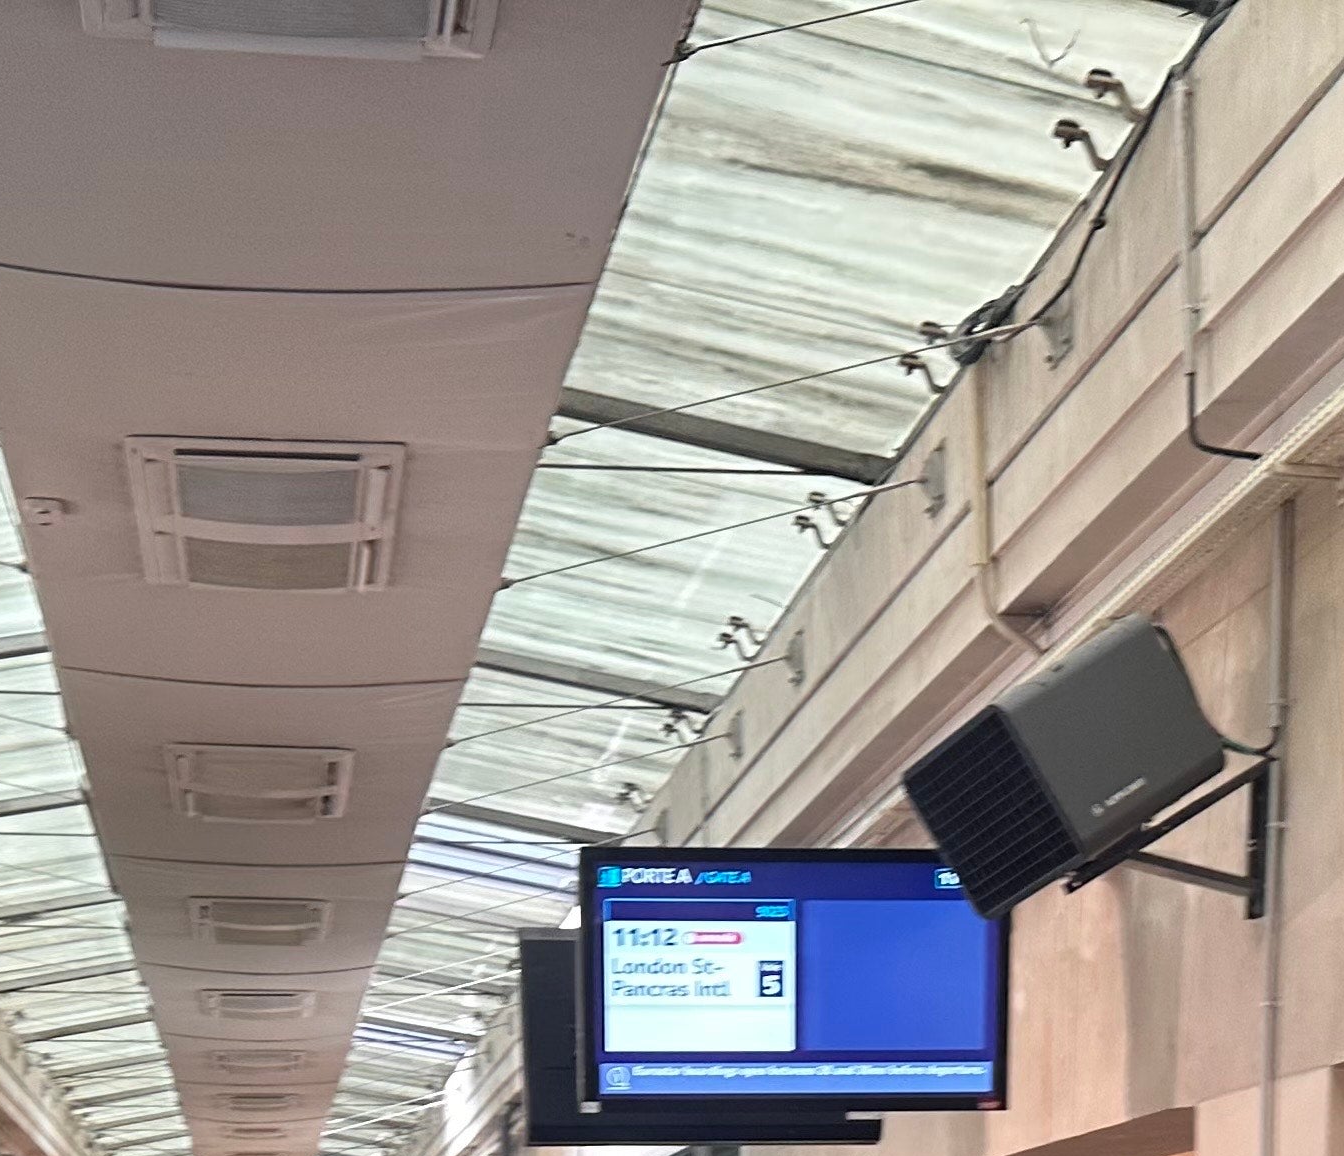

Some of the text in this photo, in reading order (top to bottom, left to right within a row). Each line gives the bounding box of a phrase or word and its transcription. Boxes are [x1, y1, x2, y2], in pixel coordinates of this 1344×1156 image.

[612, 927, 677, 946] 11:12
[611, 958, 687, 975] London
[611, 979, 691, 997] Pancras
[761, 975, 782, 997] 5
